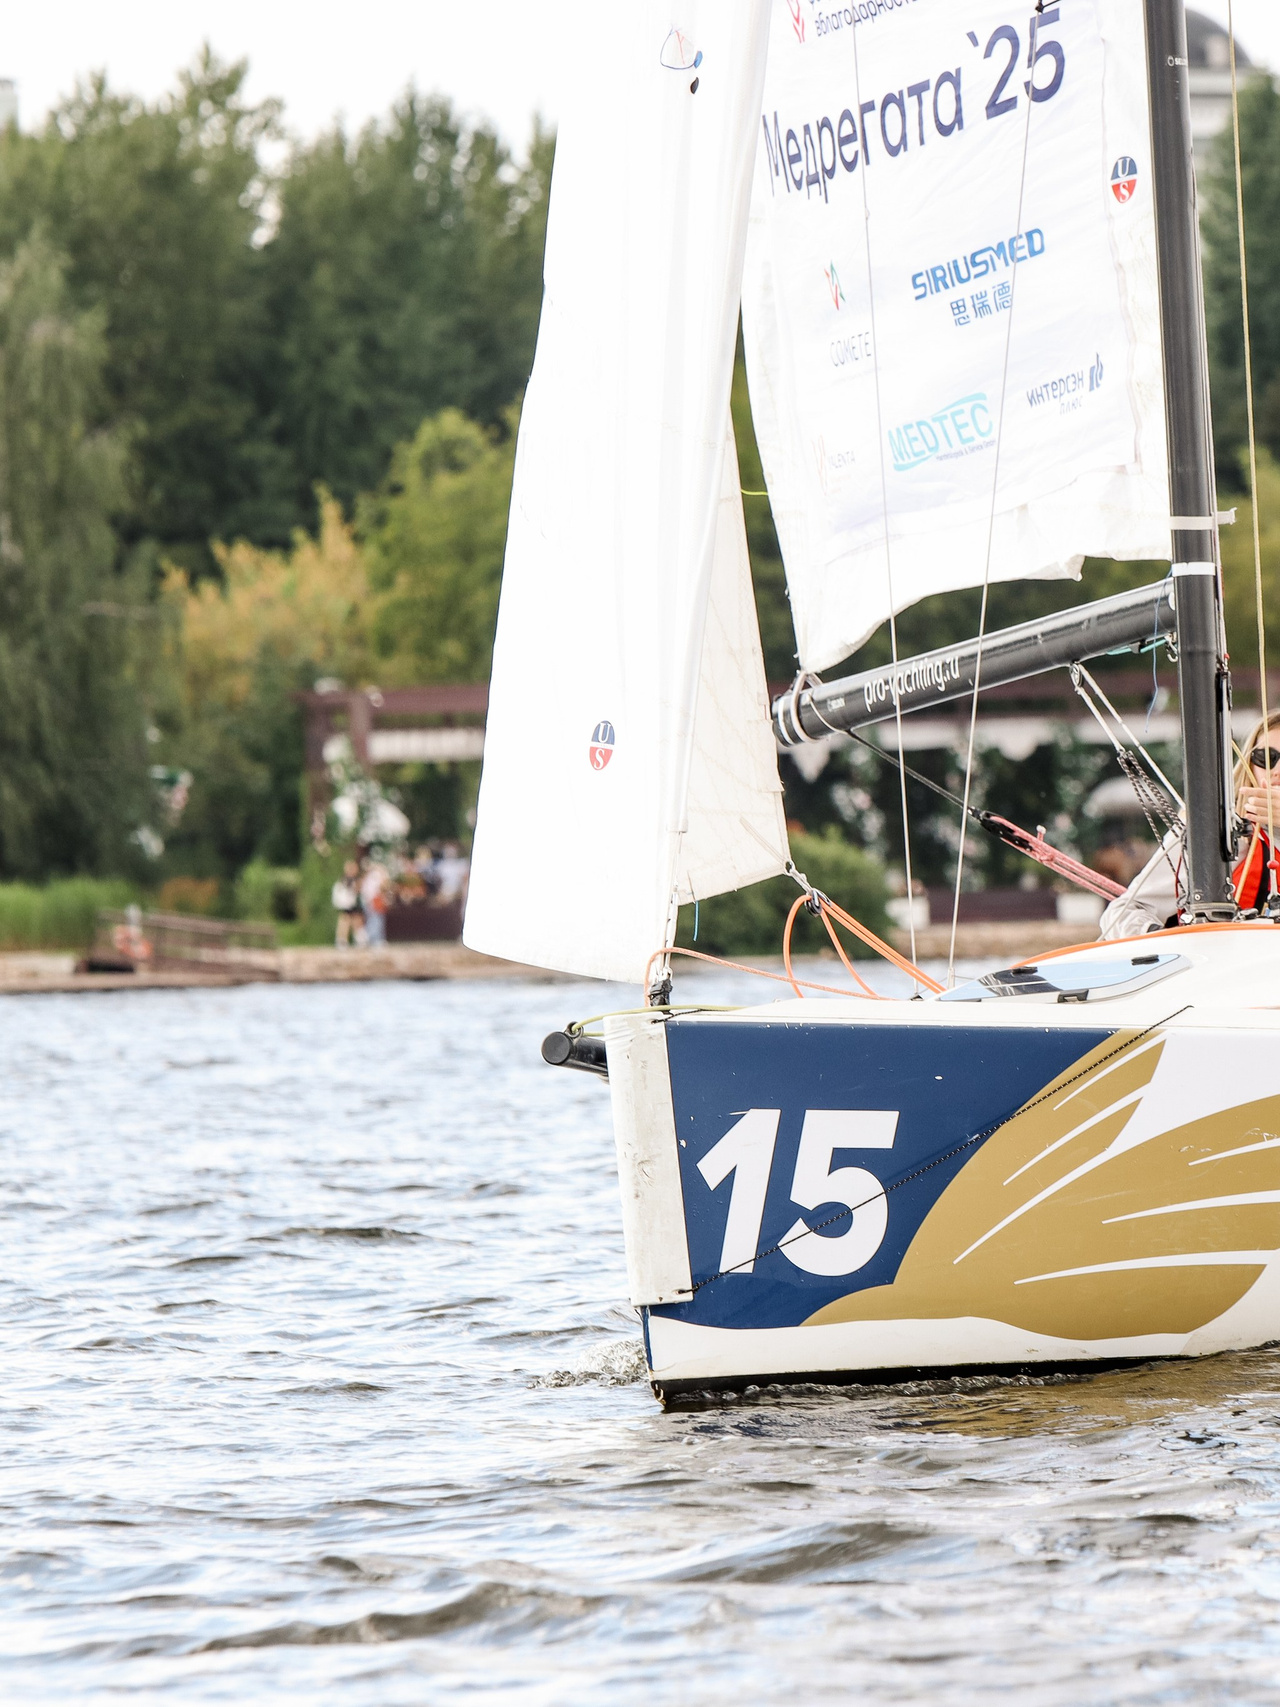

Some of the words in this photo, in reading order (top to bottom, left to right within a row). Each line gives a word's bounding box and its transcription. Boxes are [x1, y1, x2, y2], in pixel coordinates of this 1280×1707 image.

[762, 67, 963, 204] Медрегата
[911, 228, 1046, 301] SIRIUSMED
[949, 280, 1012, 327] 思瑞德
[830, 331, 872, 367] COMETE
[887, 402, 993, 464] MEDTEC
[696, 1108, 900, 1277] 15
